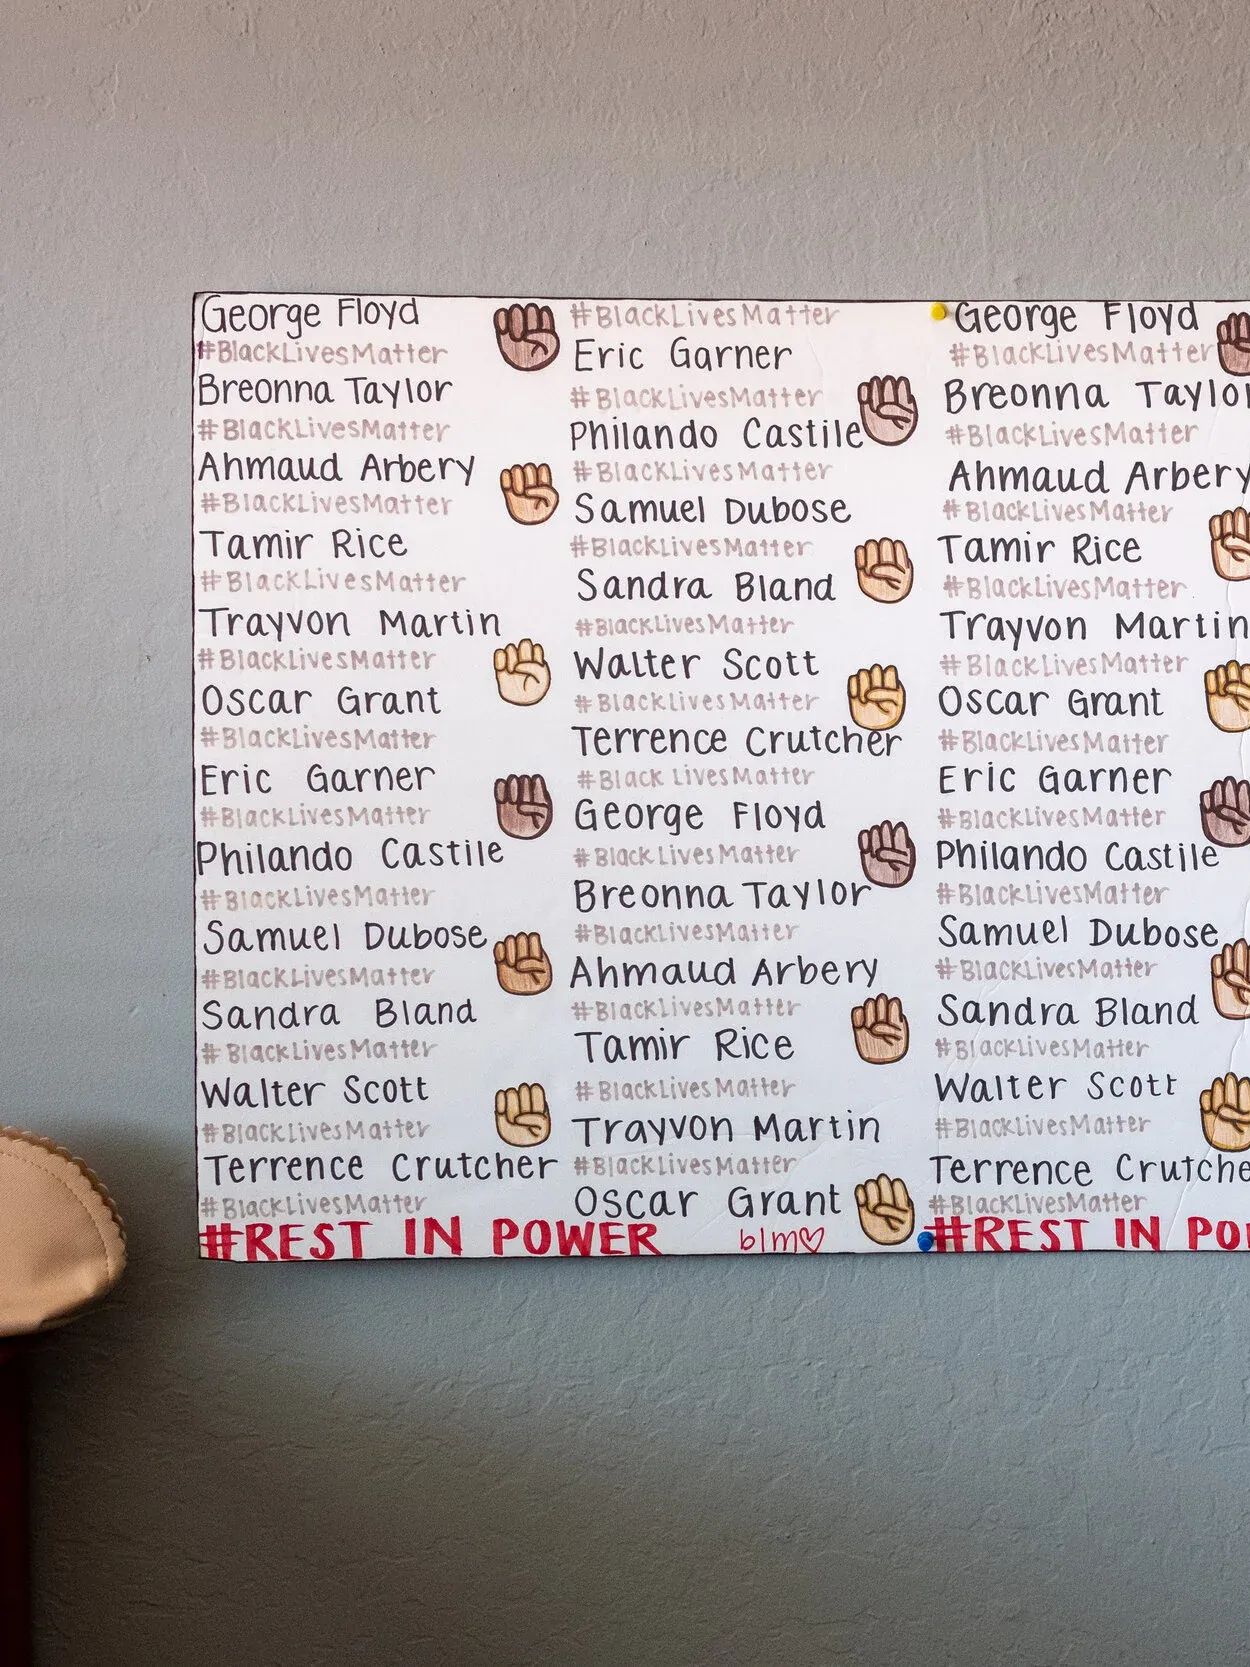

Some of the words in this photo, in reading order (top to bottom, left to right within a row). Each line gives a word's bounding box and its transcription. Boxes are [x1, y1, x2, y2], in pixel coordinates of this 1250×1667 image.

[200, 295, 321, 338] George
[339, 298, 419, 330] Floyd
[955, 303, 1077, 338] George
[1104, 303, 1198, 333] Floyd
[198, 339, 448, 367] #BlackLivesMatter
[575, 339, 643, 371] Eric
[671, 336, 792, 371] Garner
[949, 339, 1214, 368] #BlackLivesMatter
[199, 374, 334, 406] Breonna
[344, 377, 452, 409] Taylor
[945, 379, 1109, 414] Breonna
[570, 416, 717, 451] Philando
[743, 417, 863, 451] Castile
[198, 452, 343, 481] Ahmaud
[360, 454, 474, 486] Arbery
[573, 459, 832, 483] #BlackLivesMatter
[949, 460, 1110, 493] Ahmaud
[201, 492, 452, 515] #BlackLivesMatter
[576, 493, 704, 524] Samuel
[725, 496, 851, 524] Dubose
[199, 530, 313, 560] Tamir
[332, 528, 407, 558] Rice
[937, 535, 1055, 564] Tamir
[1073, 533, 1141, 566] Rice
[578, 568, 712, 601] Sandra
[735, 572, 836, 602] Bland
[943, 574, 1187, 600] #BlackLivesMatter
[198, 608, 350, 642] Trayvon
[380, 609, 500, 638] Martin
[575, 614, 794, 637] #BlackLivesMatter
[939, 610, 1088, 643] Trayvon
[1116, 611, 1248, 639] Martin
[197, 648, 436, 672] #BlackLivesMatter
[574, 647, 700, 679] Walter
[724, 648, 819, 680] Scott
[203, 685, 312, 716] Oscar
[338, 687, 441, 716] Grant
[939, 686, 1049, 716] Oscar
[1068, 688, 1164, 718] Grant
[571, 726, 727, 756] Terrence
[745, 725, 903, 758] Crutcher
[938, 729, 1169, 755] #BlackLivesMatter
[202, 764, 271, 795] Eric
[307, 764, 435, 793] Garner
[940, 762, 1015, 794] Eric
[1039, 765, 1172, 795] Garner
[575, 799, 703, 836] George
[734, 800, 825, 832] Floyd
[197, 841, 352, 876] Philando
[382, 838, 503, 869] Castile
[937, 839, 1087, 872] Philando
[1105, 841, 1219, 872] Castile
[200, 885, 435, 911] #BlackLivesMatter
[574, 880, 734, 912] Breonna
[741, 878, 872, 911] Taylor
[936, 880, 1169, 906] #BlackLivesMatter
[204, 920, 339, 954] Samuel
[365, 922, 487, 950] Dubose
[575, 922, 799, 945] #BlackLivesMatter
[939, 915, 1067, 947] Samuel
[1089, 917, 1218, 948] Dubose
[570, 956, 736, 988] Ahmaud
[752, 955, 877, 987] Arbery
[203, 1000, 340, 1030] Sandra
[376, 998, 477, 1028] Bland
[938, 994, 1079, 1026] Sandra
[1095, 994, 1199, 1027] Bland
[201, 1039, 437, 1065] #BlackLivesMatter
[574, 1028, 690, 1063] Tamir
[715, 1027, 794, 1061] Rice
[201, 1077, 325, 1108] Walter
[344, 1075, 428, 1104] Scott
[575, 1076, 796, 1102] #BlackLivesMatter
[935, 1073, 1066, 1103] Walter
[1088, 1072, 1177, 1099] Scott
[571, 1115, 732, 1147] Trayvon
[754, 1110, 879, 1143] Martin
[935, 1114, 1151, 1139] #BlackLivesMatter
[204, 1155, 363, 1185] Terrence
[393, 1152, 558, 1182] Crutcher
[930, 1156, 1092, 1186] Terrence
[201, 1192, 427, 1220] #BlackLivesMatter
[575, 1186, 698, 1219] Oscar
[728, 1184, 841, 1218] Grant
[200, 1222, 368, 1262] #REST
[405, 1216, 462, 1255] IN
[493, 1218, 662, 1257] POWER
[741, 1230, 797, 1250] blm
[925, 1216, 1091, 1252] #REST
[1115, 1216, 1160, 1251] IN
